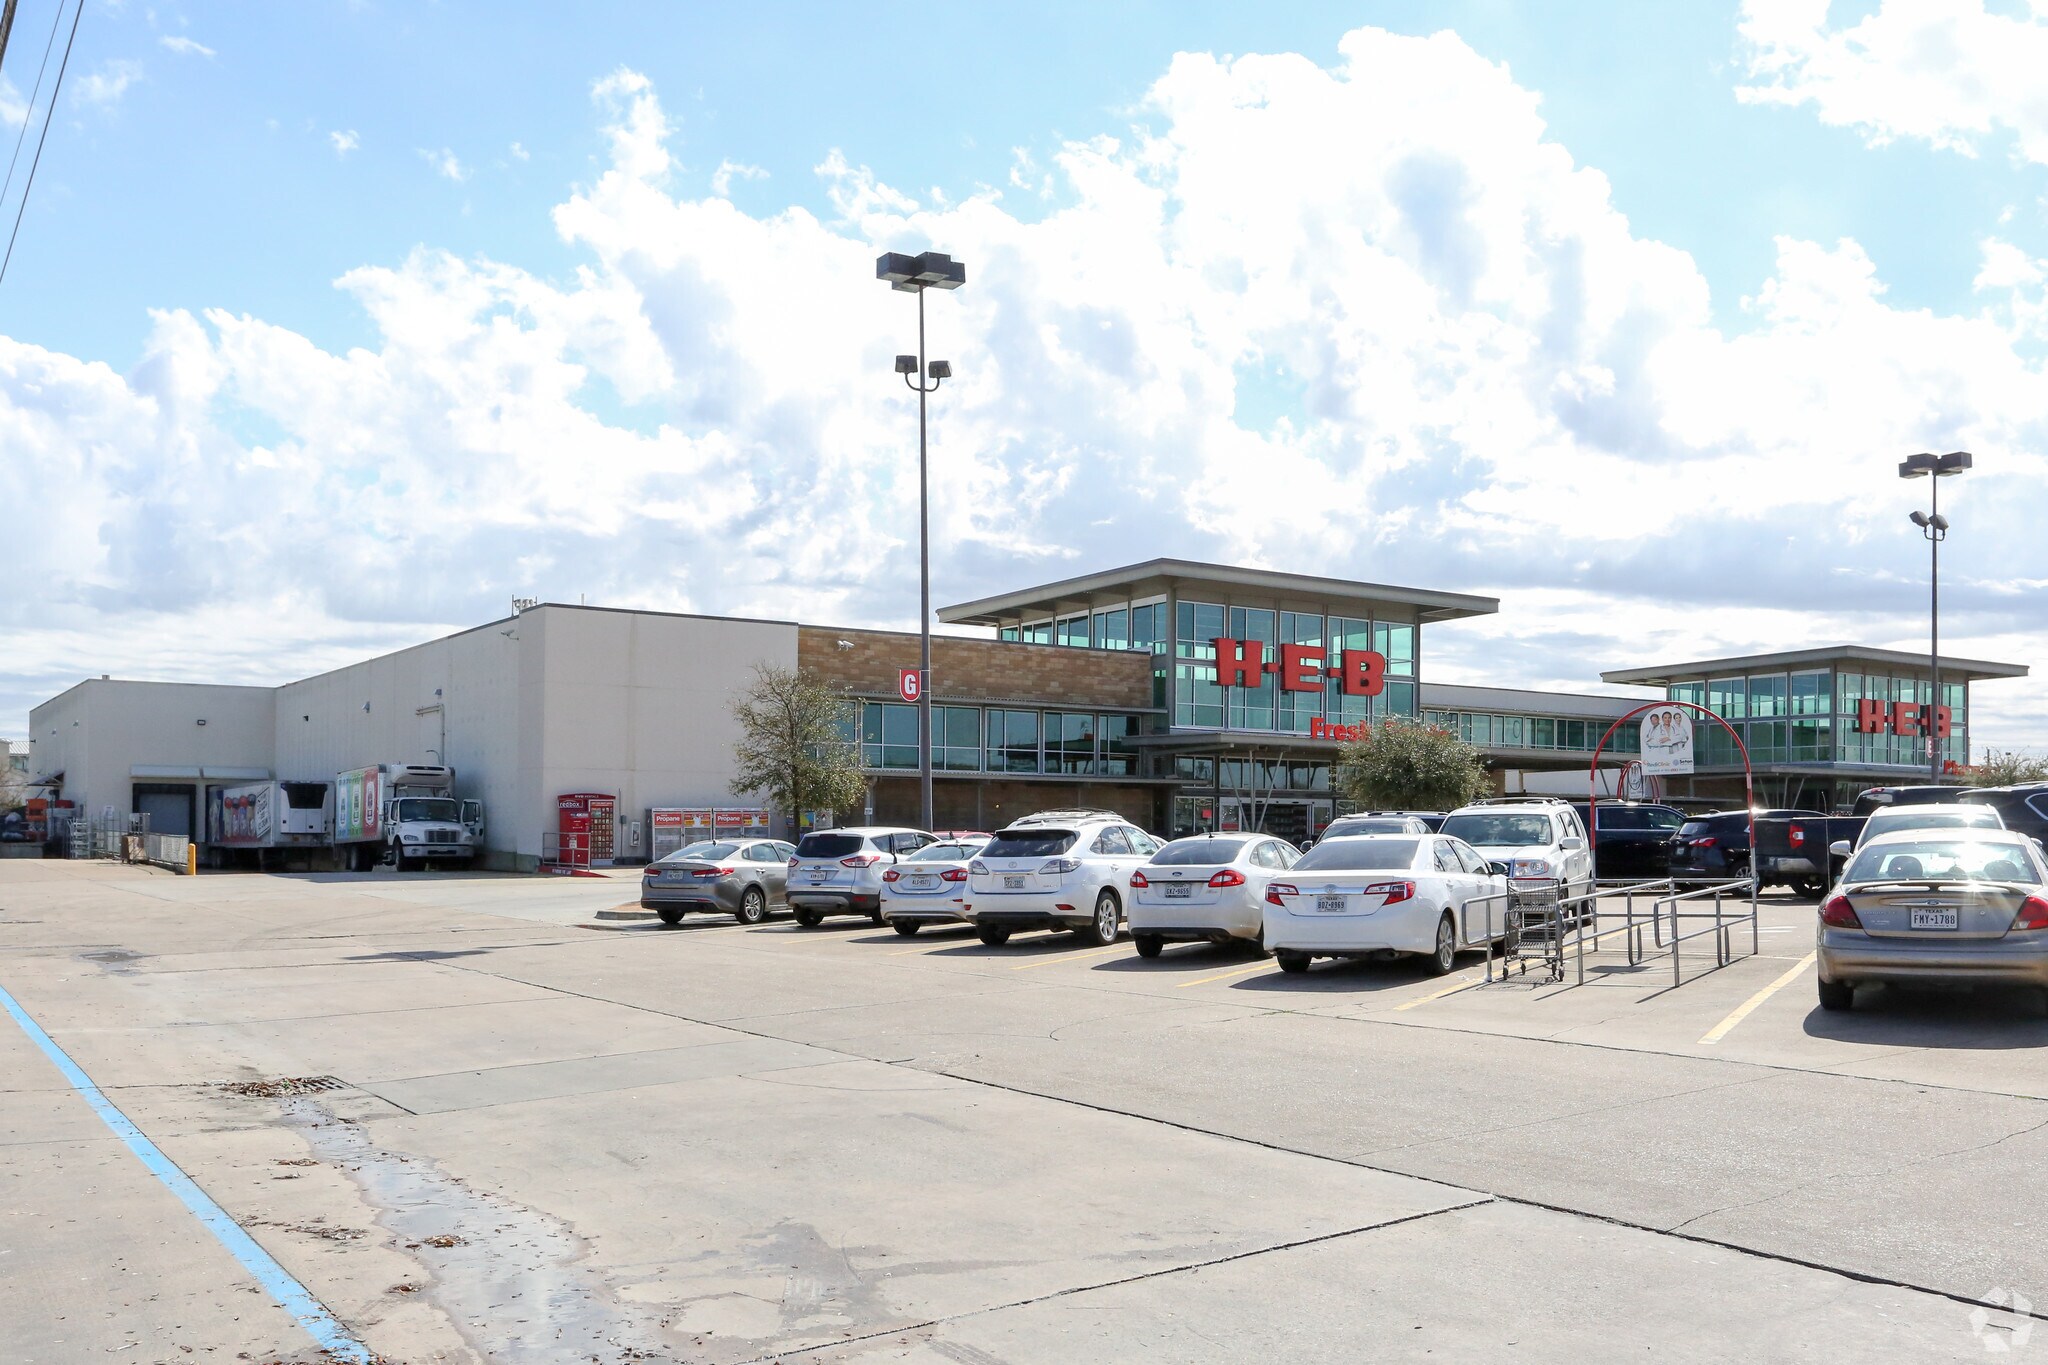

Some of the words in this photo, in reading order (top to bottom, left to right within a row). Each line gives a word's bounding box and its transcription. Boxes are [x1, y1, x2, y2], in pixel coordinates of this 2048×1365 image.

[904, 674, 917, 695] G
[656, 815, 681, 823] Propane
[717, 815, 741, 823] Propane
